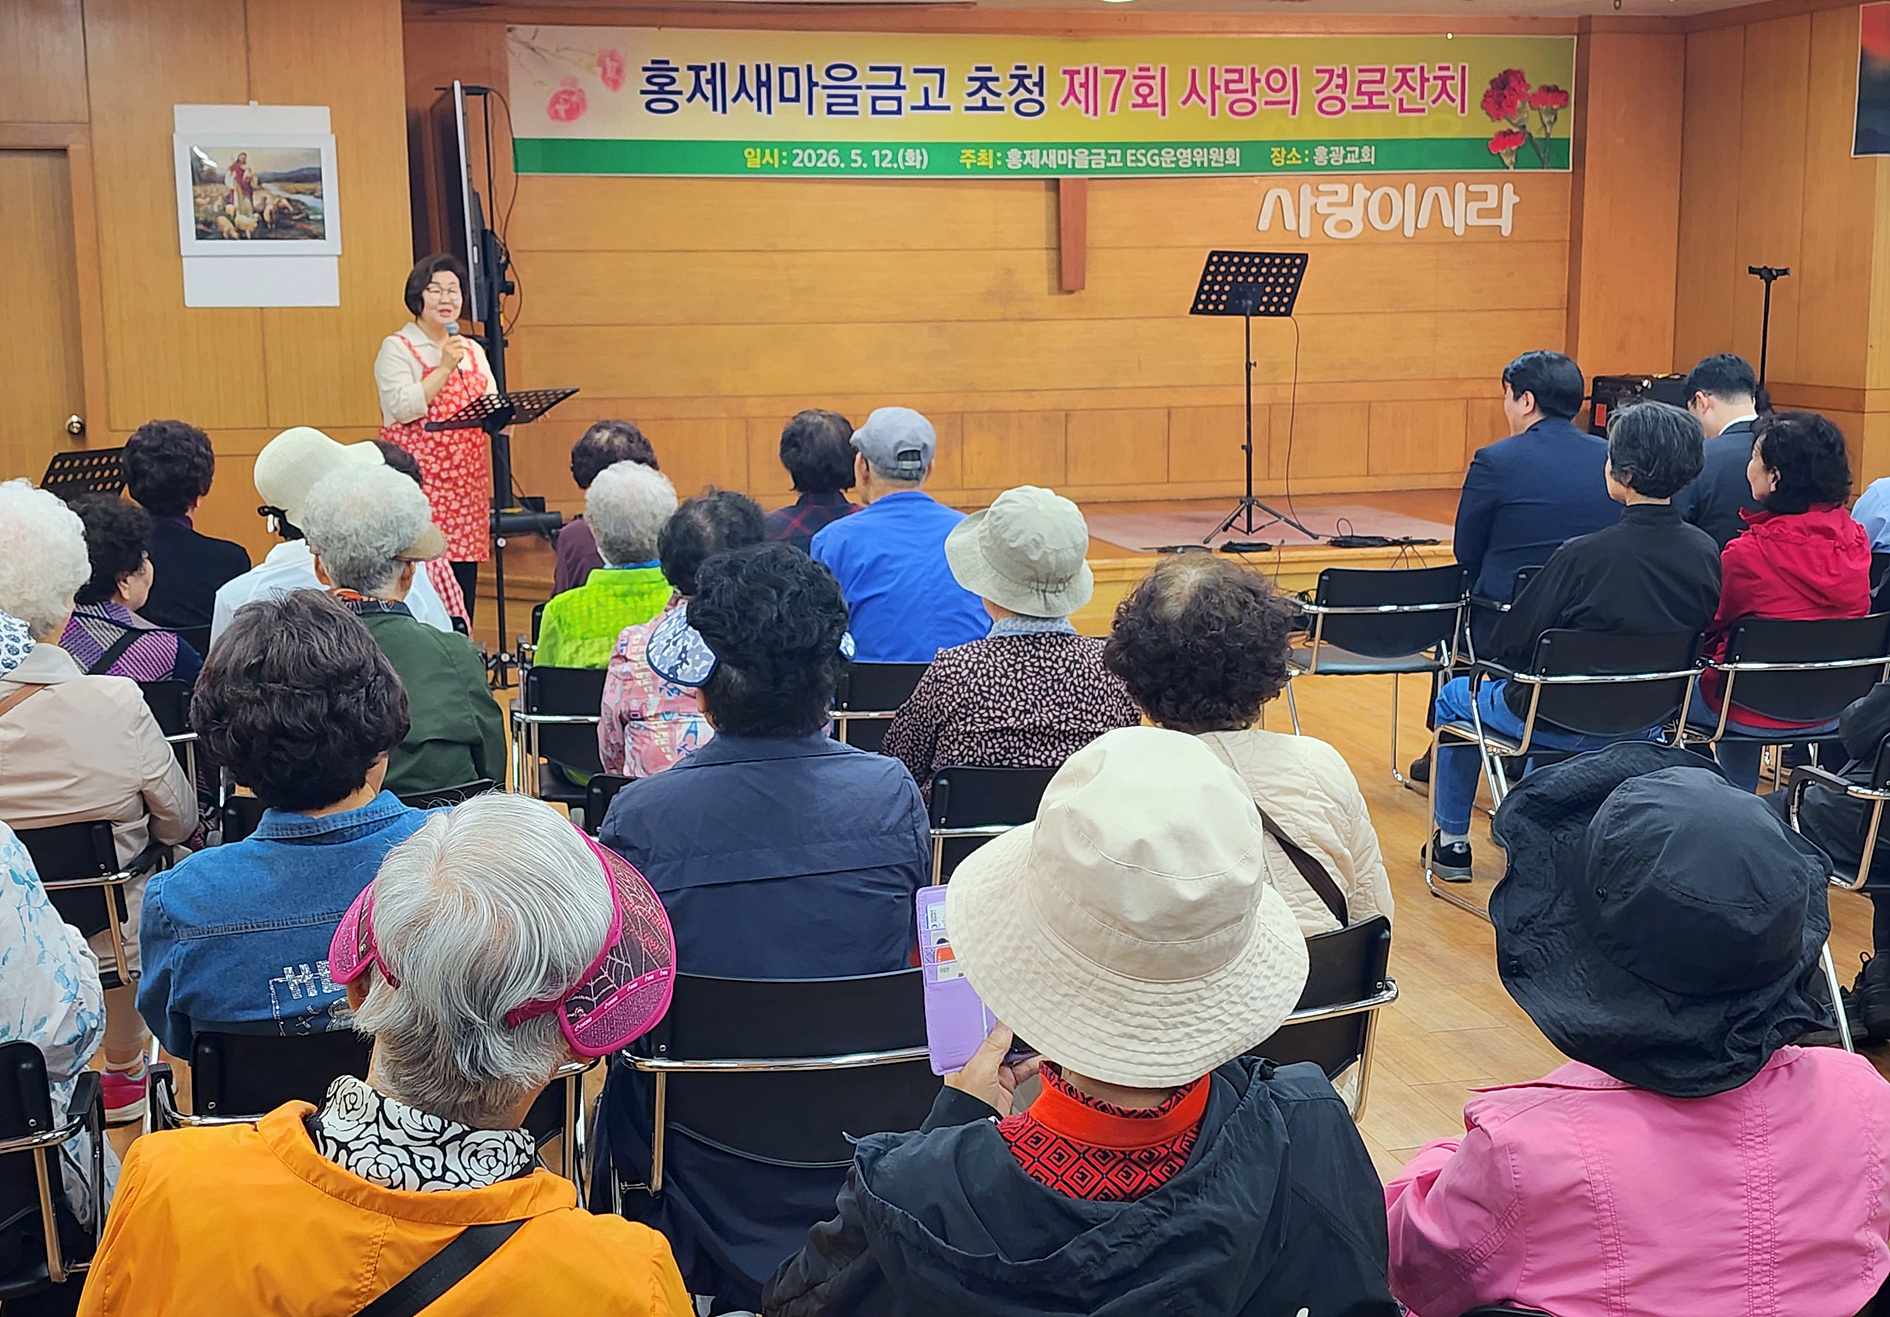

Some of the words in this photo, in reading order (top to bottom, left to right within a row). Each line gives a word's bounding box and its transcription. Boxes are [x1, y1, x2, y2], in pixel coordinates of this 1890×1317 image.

[638, 58, 952, 117] 홍제새마을금고
[963, 64, 1046, 118] 초청
[1060, 64, 1167, 119] 제7회
[1181, 63, 1299, 118] 사랑의
[1314, 63, 1468, 116] 경로잔치
[791, 149, 846, 169] 2026.
[1005, 147, 1124, 169] 홍제새마을금고
[1127, 147, 1240, 168] ESG운영위원회
[1313, 145, 1376, 166] 홍광교회
[1257, 183, 1519, 239] 사랑이시라
